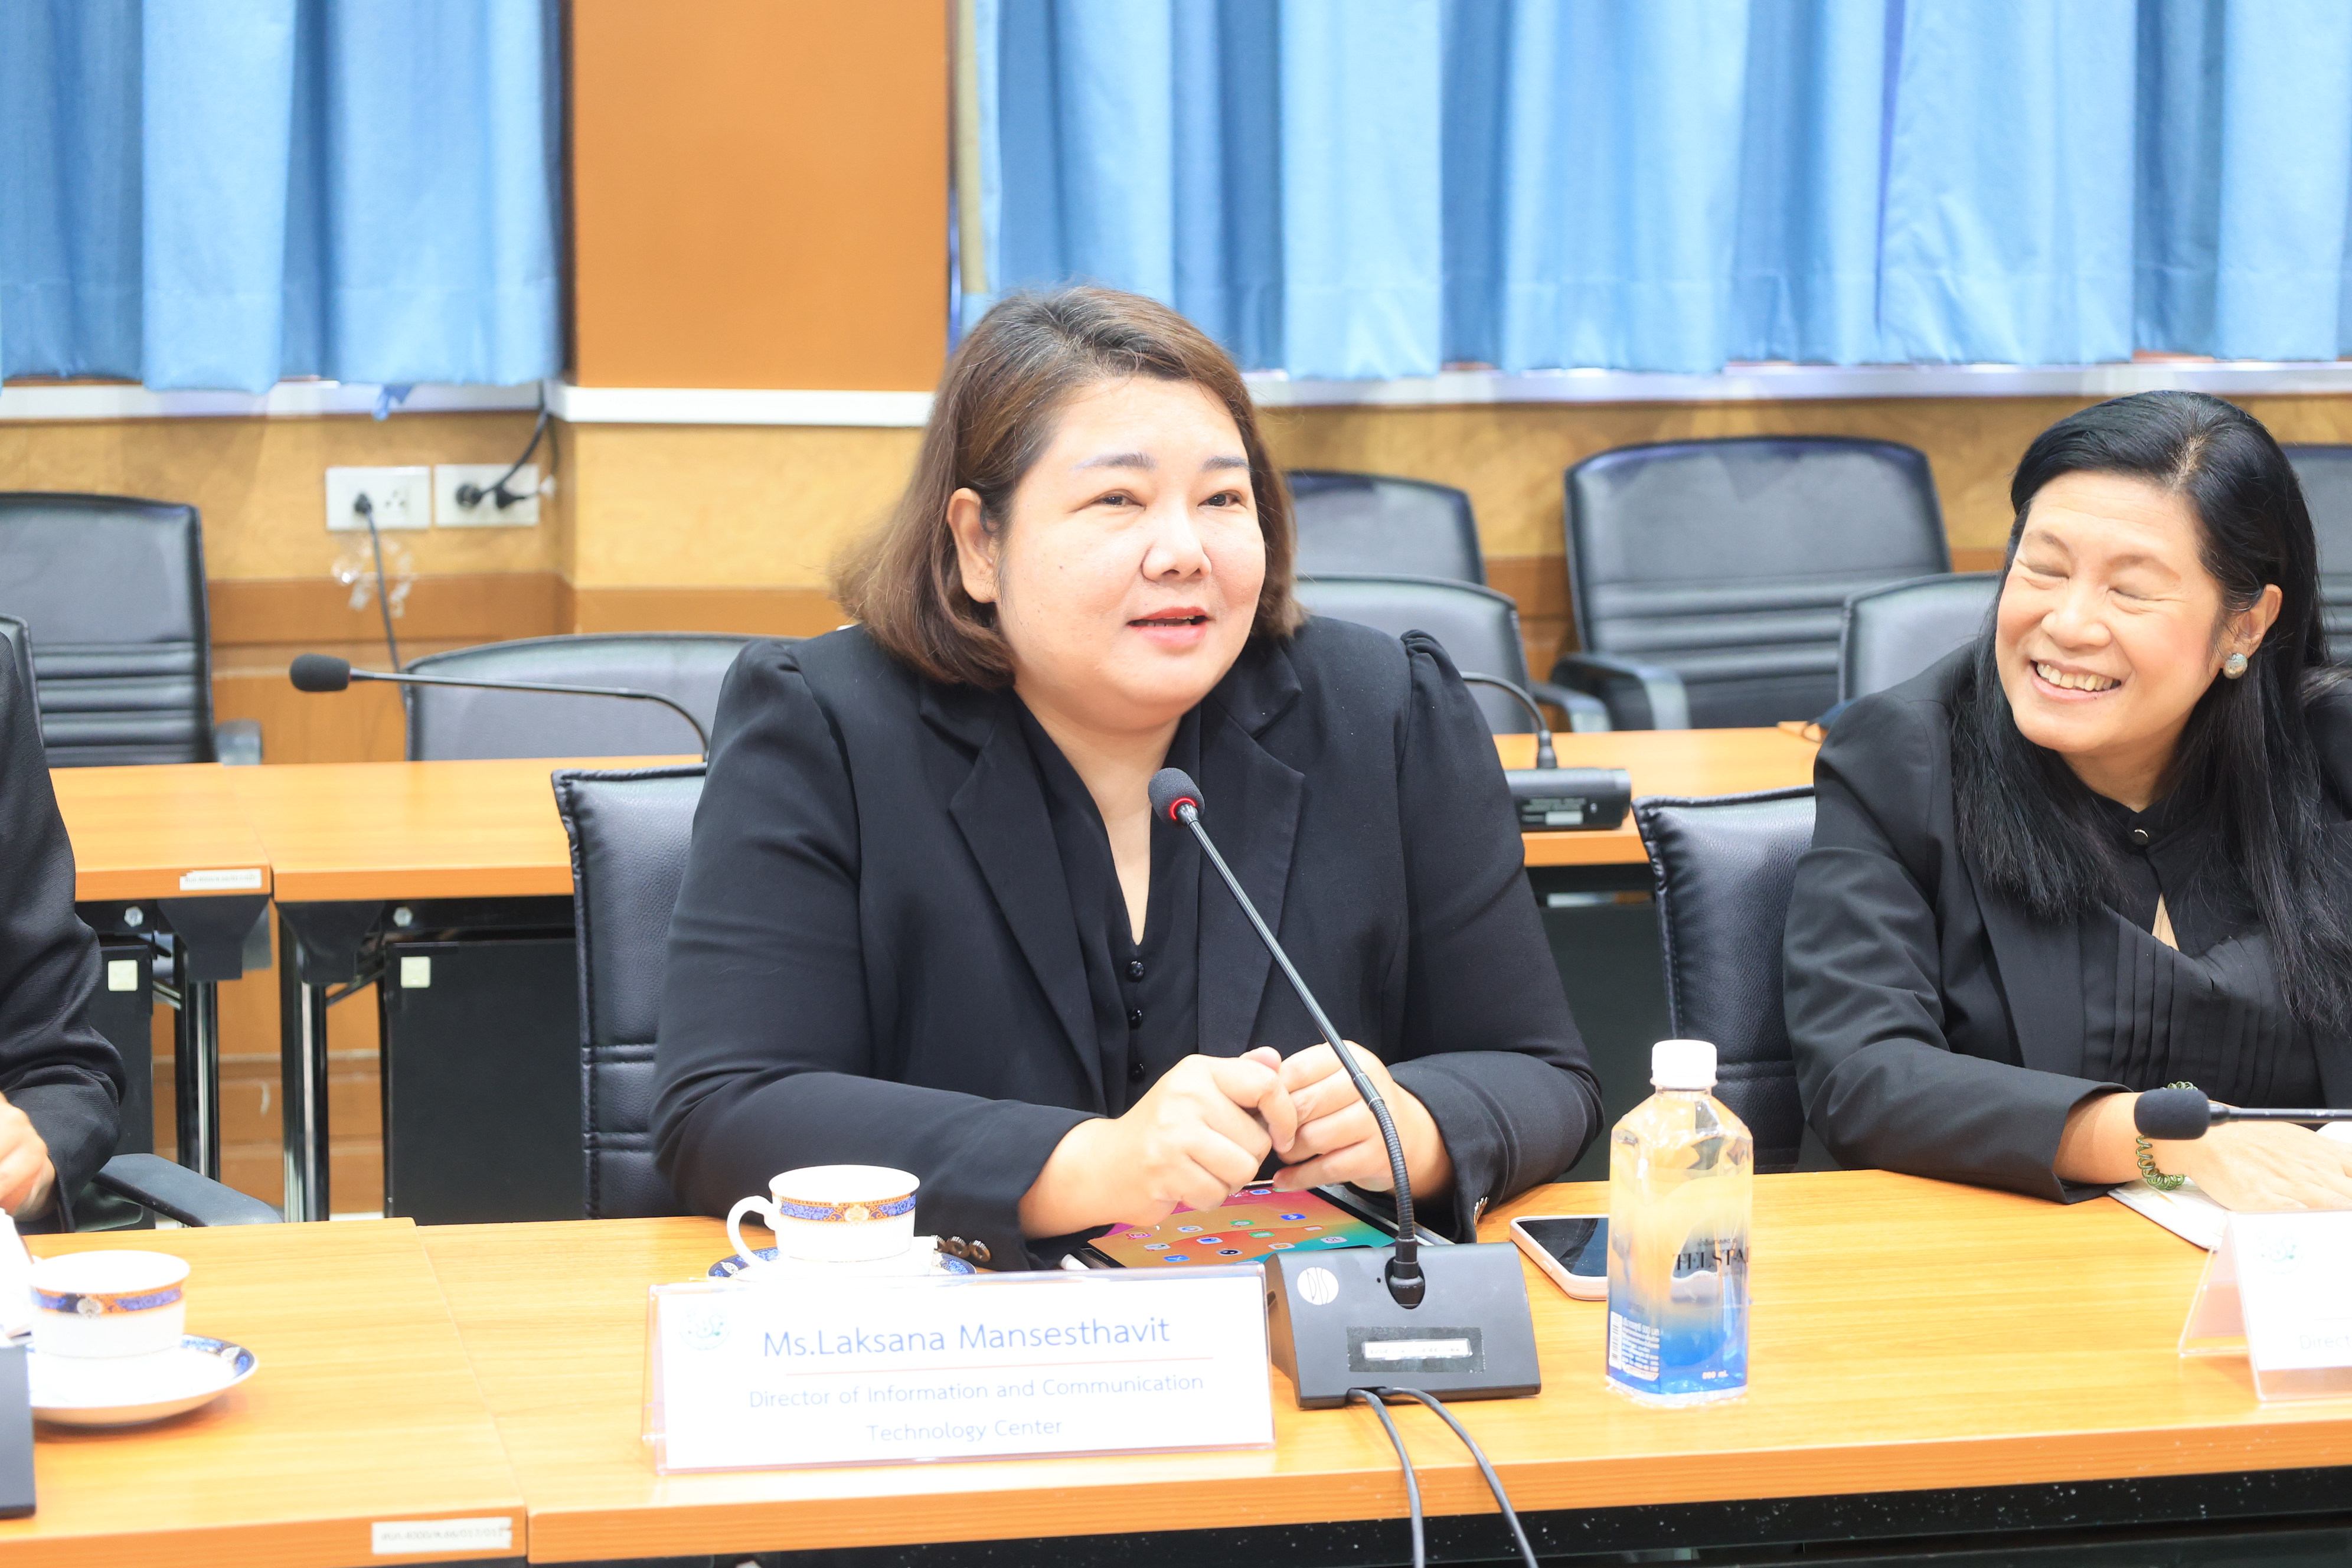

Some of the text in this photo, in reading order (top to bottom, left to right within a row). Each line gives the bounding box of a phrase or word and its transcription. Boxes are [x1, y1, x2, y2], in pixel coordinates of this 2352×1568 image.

[765, 1327, 945, 1357] Ms.Laksana
[960, 1317, 1170, 1350] Mansesthavit
[750, 1376, 1203, 1407] Director of Information and Communication
[867, 1420, 1061, 1442] Technology Center
